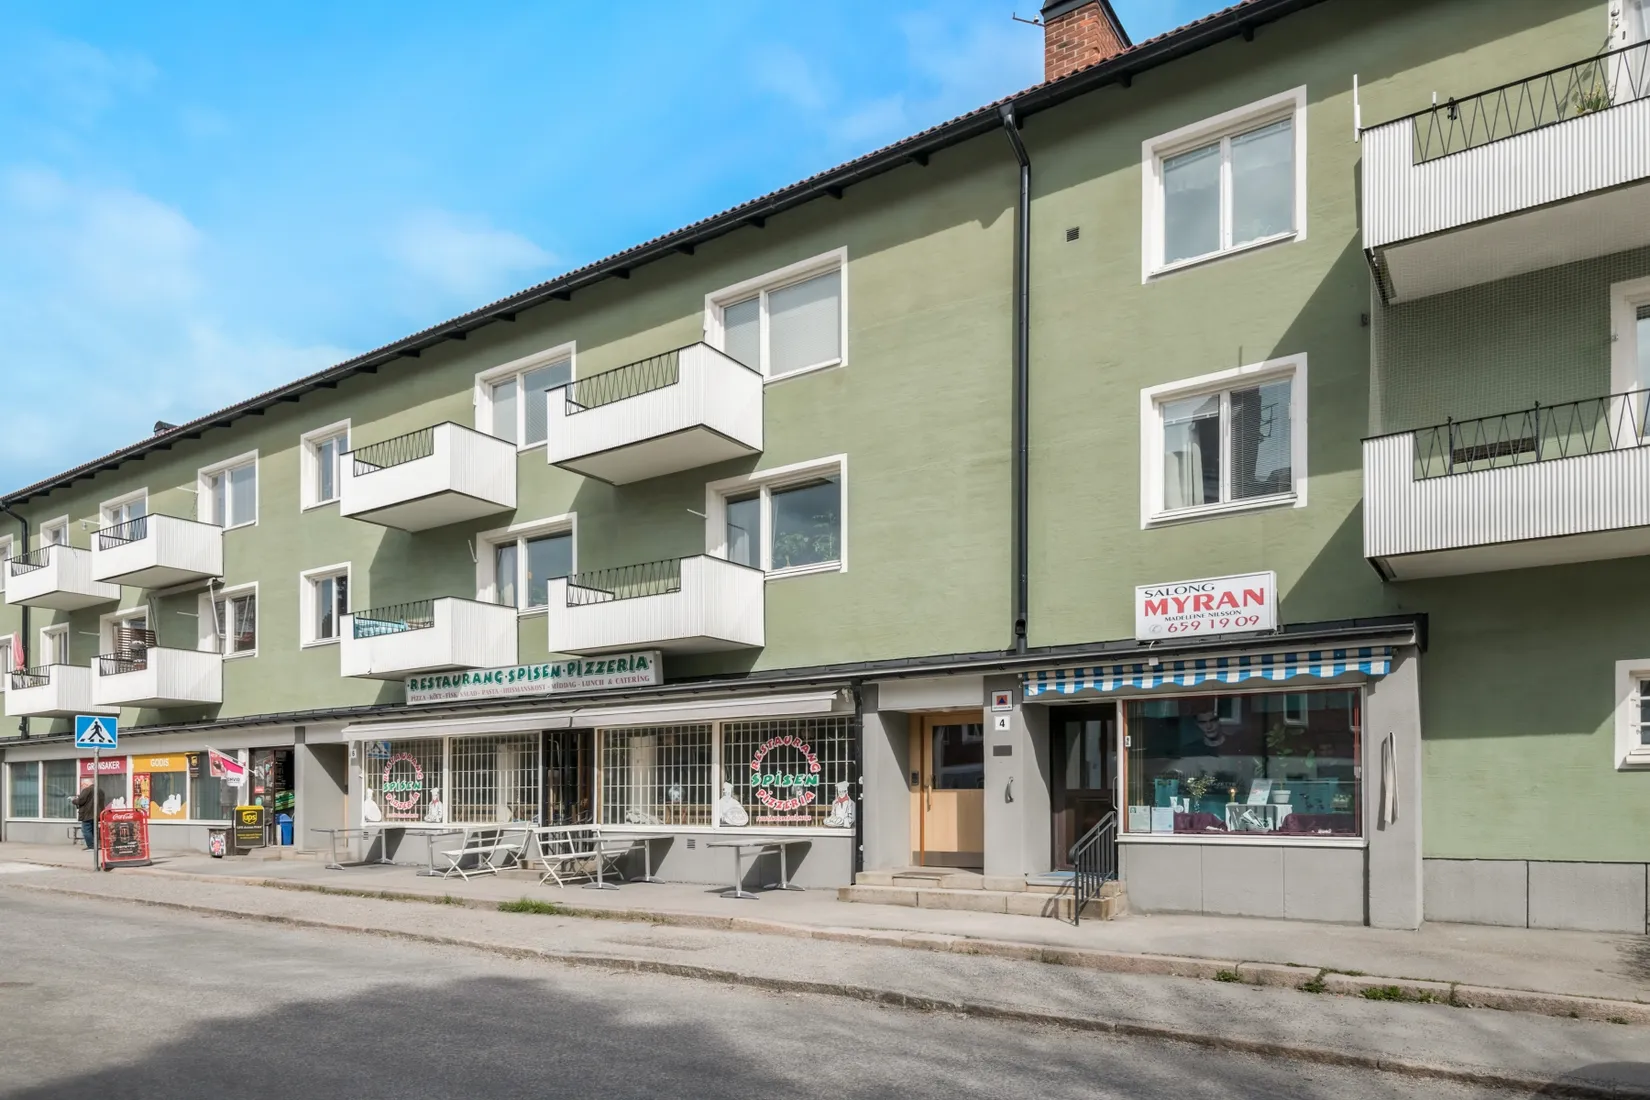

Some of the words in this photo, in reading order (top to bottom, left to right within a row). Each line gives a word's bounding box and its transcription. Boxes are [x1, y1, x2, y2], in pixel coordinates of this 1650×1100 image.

[1144, 583, 1215, 598] SALONG
[1144, 588, 1264, 617] MYRAN
[1164, 613, 1205, 622] MADELEINE
[1208, 609, 1242, 618] NILSSON
[1167, 620, 1201, 633] 659
[999, 718, 1005, 728] 4
[750, 734, 822, 773] RESTAURANG
[86, 760, 120, 771] GRNSAKER
[150, 758, 169, 767] GODIS
